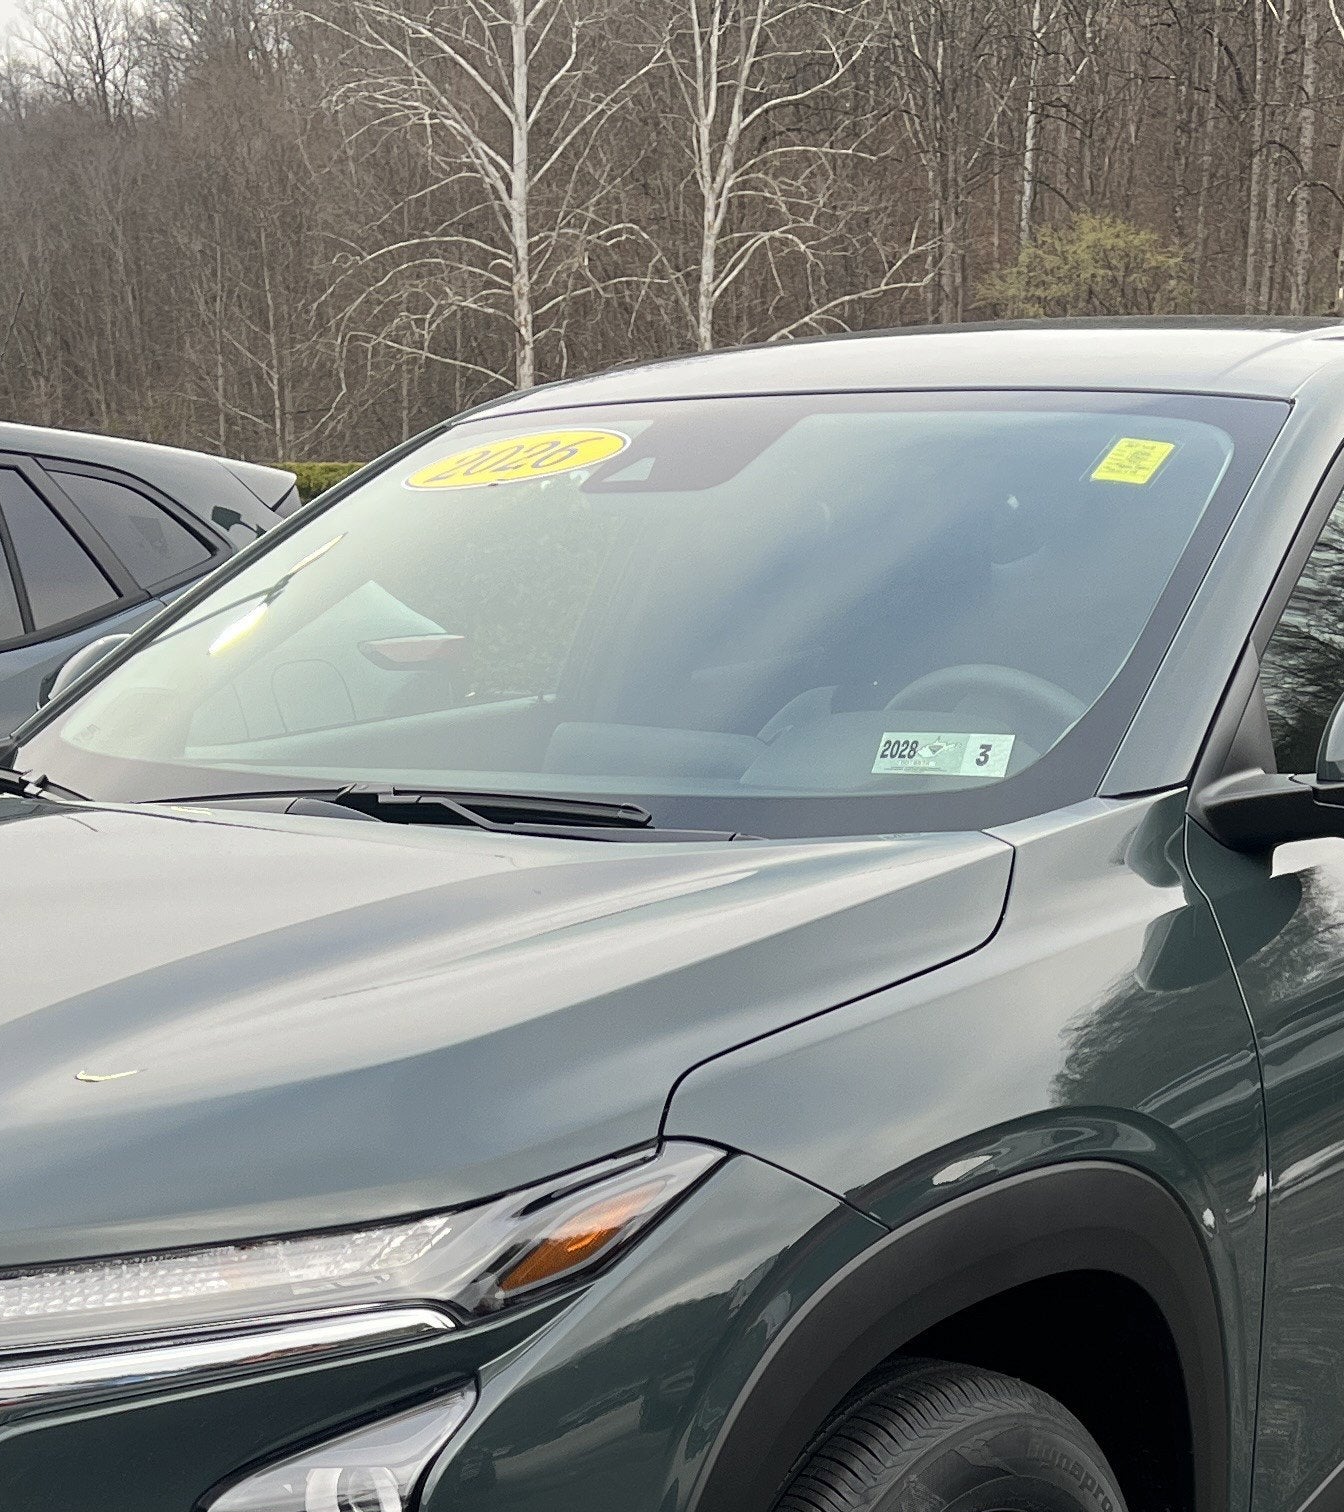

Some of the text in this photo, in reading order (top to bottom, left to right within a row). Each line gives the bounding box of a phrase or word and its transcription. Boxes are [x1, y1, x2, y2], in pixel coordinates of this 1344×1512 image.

[423, 435, 605, 484] 2026
[879, 740, 993, 767] 2028 3
